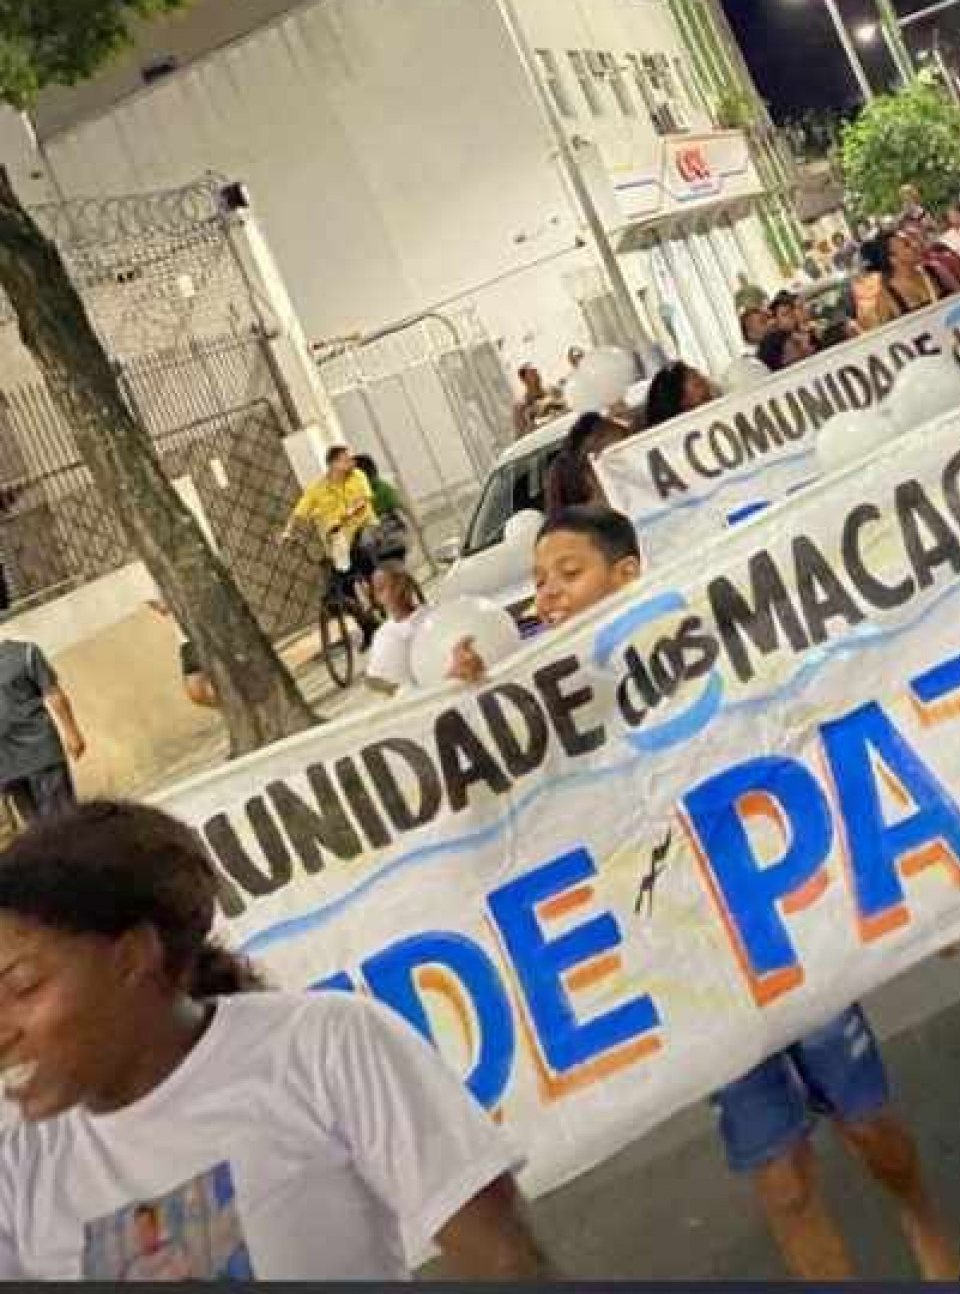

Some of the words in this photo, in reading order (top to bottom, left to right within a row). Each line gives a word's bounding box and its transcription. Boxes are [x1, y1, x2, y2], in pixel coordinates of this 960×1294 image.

[646, 447, 688, 499] A
[203, 653, 606, 920] UNIDADE
[616, 616, 721, 726] dos
[308, 846, 662, 1122] DE
